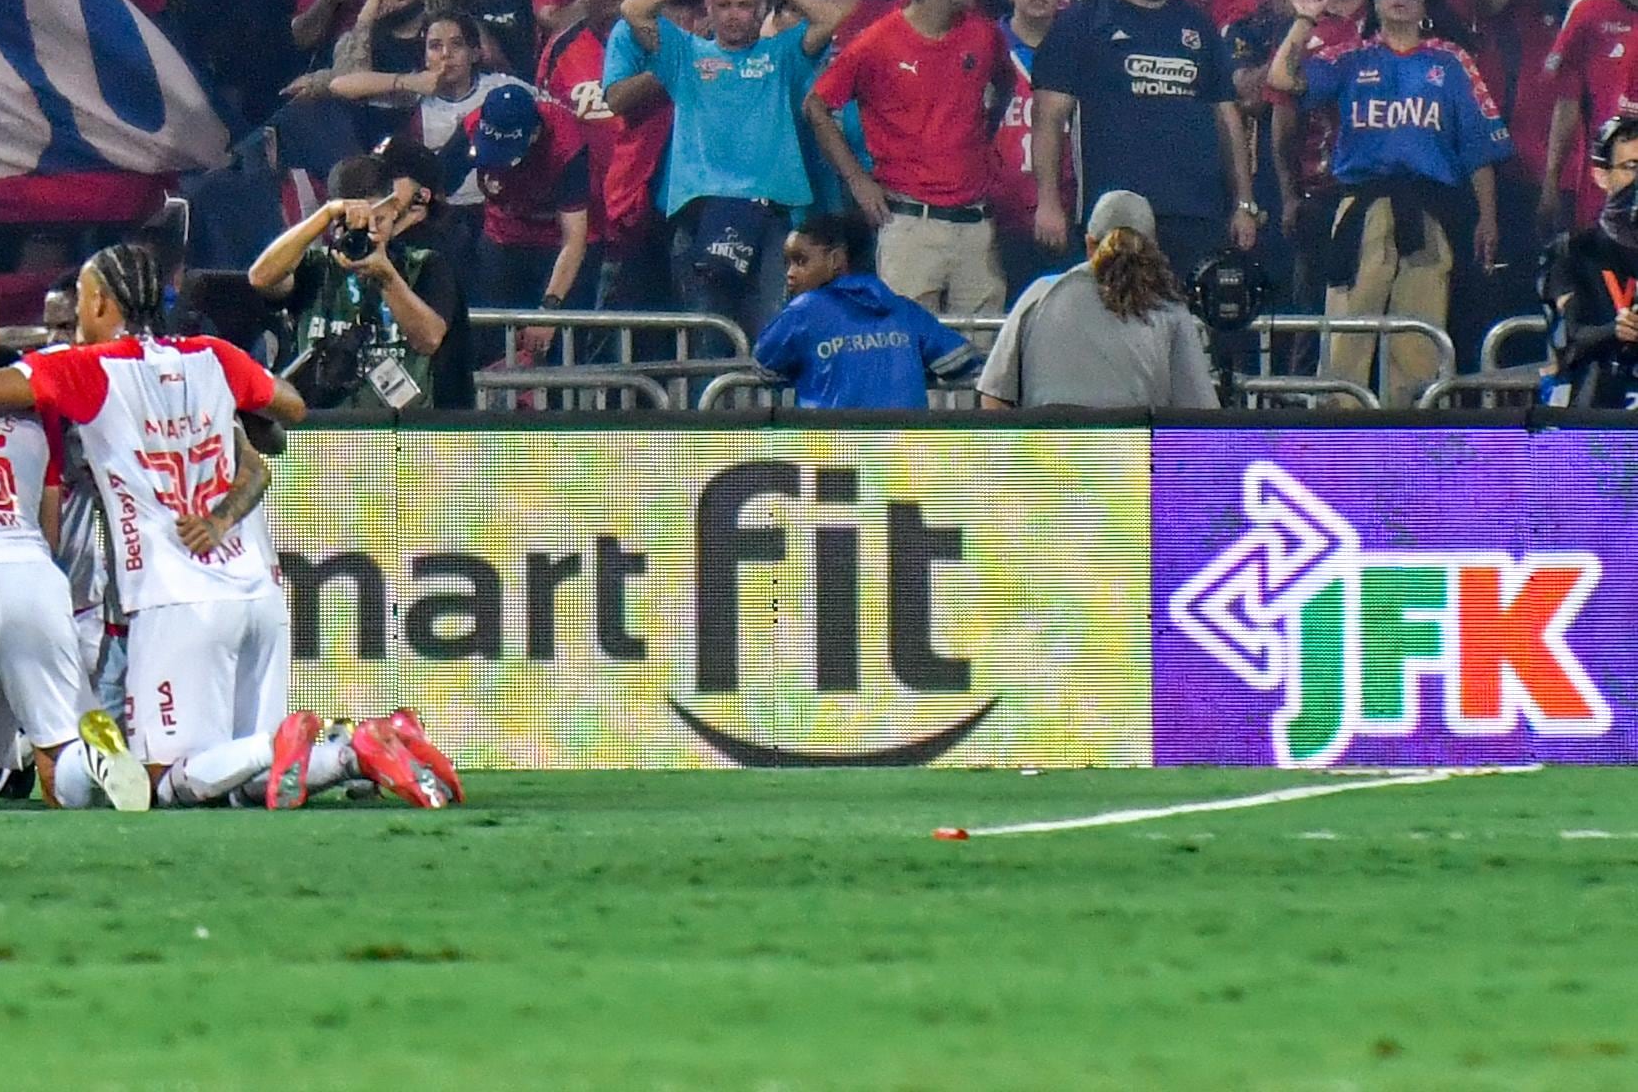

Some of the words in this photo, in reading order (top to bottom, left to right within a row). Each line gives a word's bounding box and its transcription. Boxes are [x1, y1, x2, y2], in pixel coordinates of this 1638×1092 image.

[1351, 96, 1441, 132] LEONA
[125, 493, 143, 573] BetPlay
[276, 536, 648, 662] mart
[695, 460, 972, 695] fit
[1277, 556, 1607, 763] JFK
